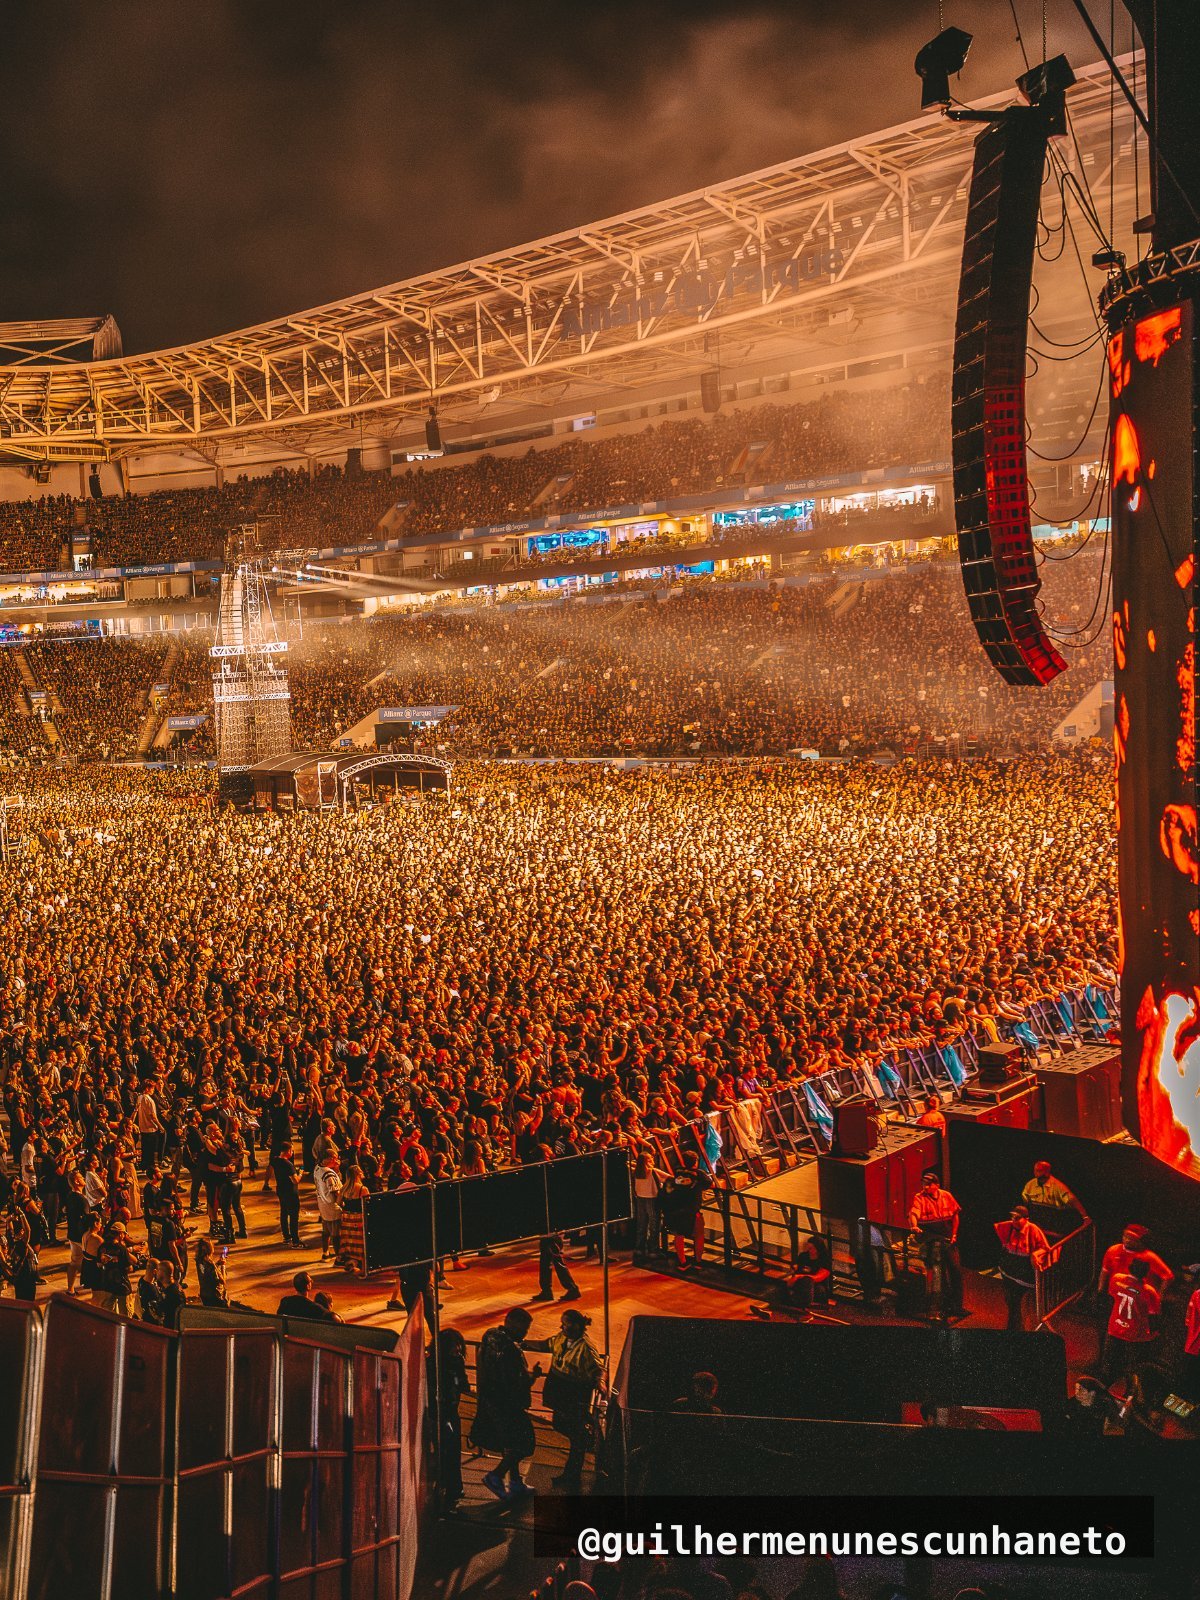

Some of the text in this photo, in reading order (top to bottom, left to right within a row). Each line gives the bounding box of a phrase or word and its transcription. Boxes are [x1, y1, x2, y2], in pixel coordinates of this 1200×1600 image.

[784, 478, 840, 490] Allianz Seguros
[413, 710, 432, 718] Parque
